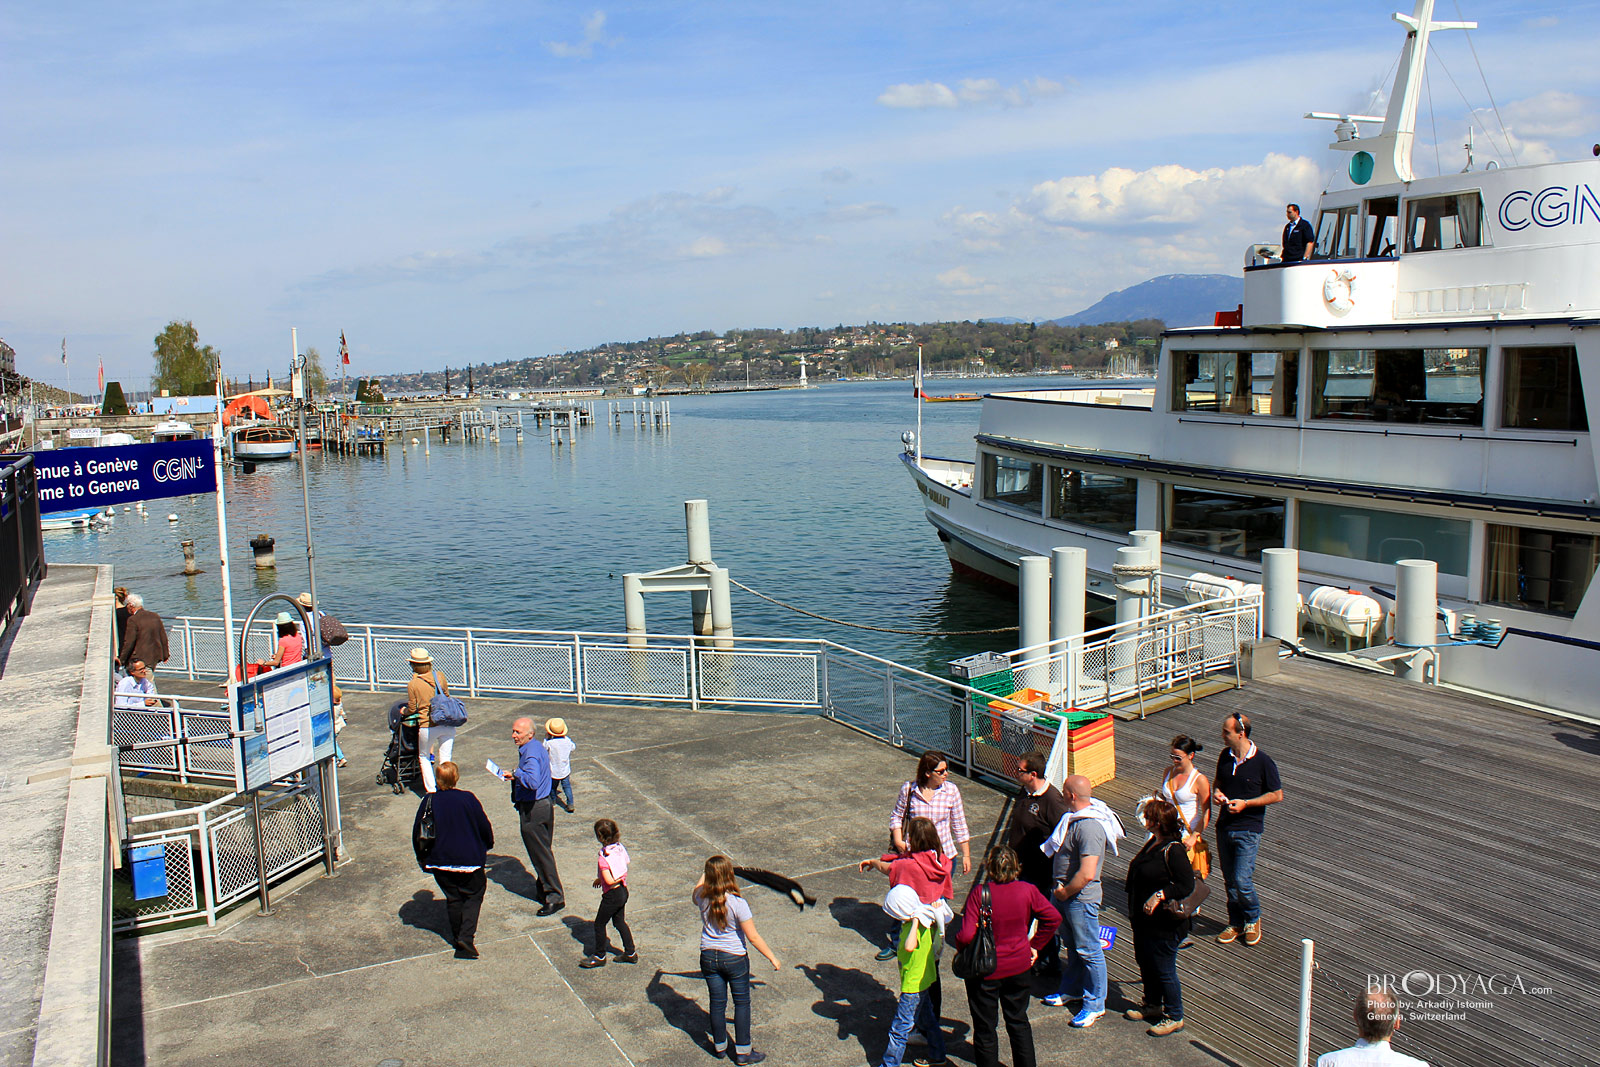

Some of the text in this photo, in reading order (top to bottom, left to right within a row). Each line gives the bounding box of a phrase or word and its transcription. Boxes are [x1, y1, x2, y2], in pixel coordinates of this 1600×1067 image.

[1498, 184, 1600, 232] CGN
[74, 461, 83, 476] à
[86, 457, 139, 475] Genève
[153, 456, 197, 483] CGN
[69, 483, 84, 497] to
[88, 479, 140, 495] Geneva
